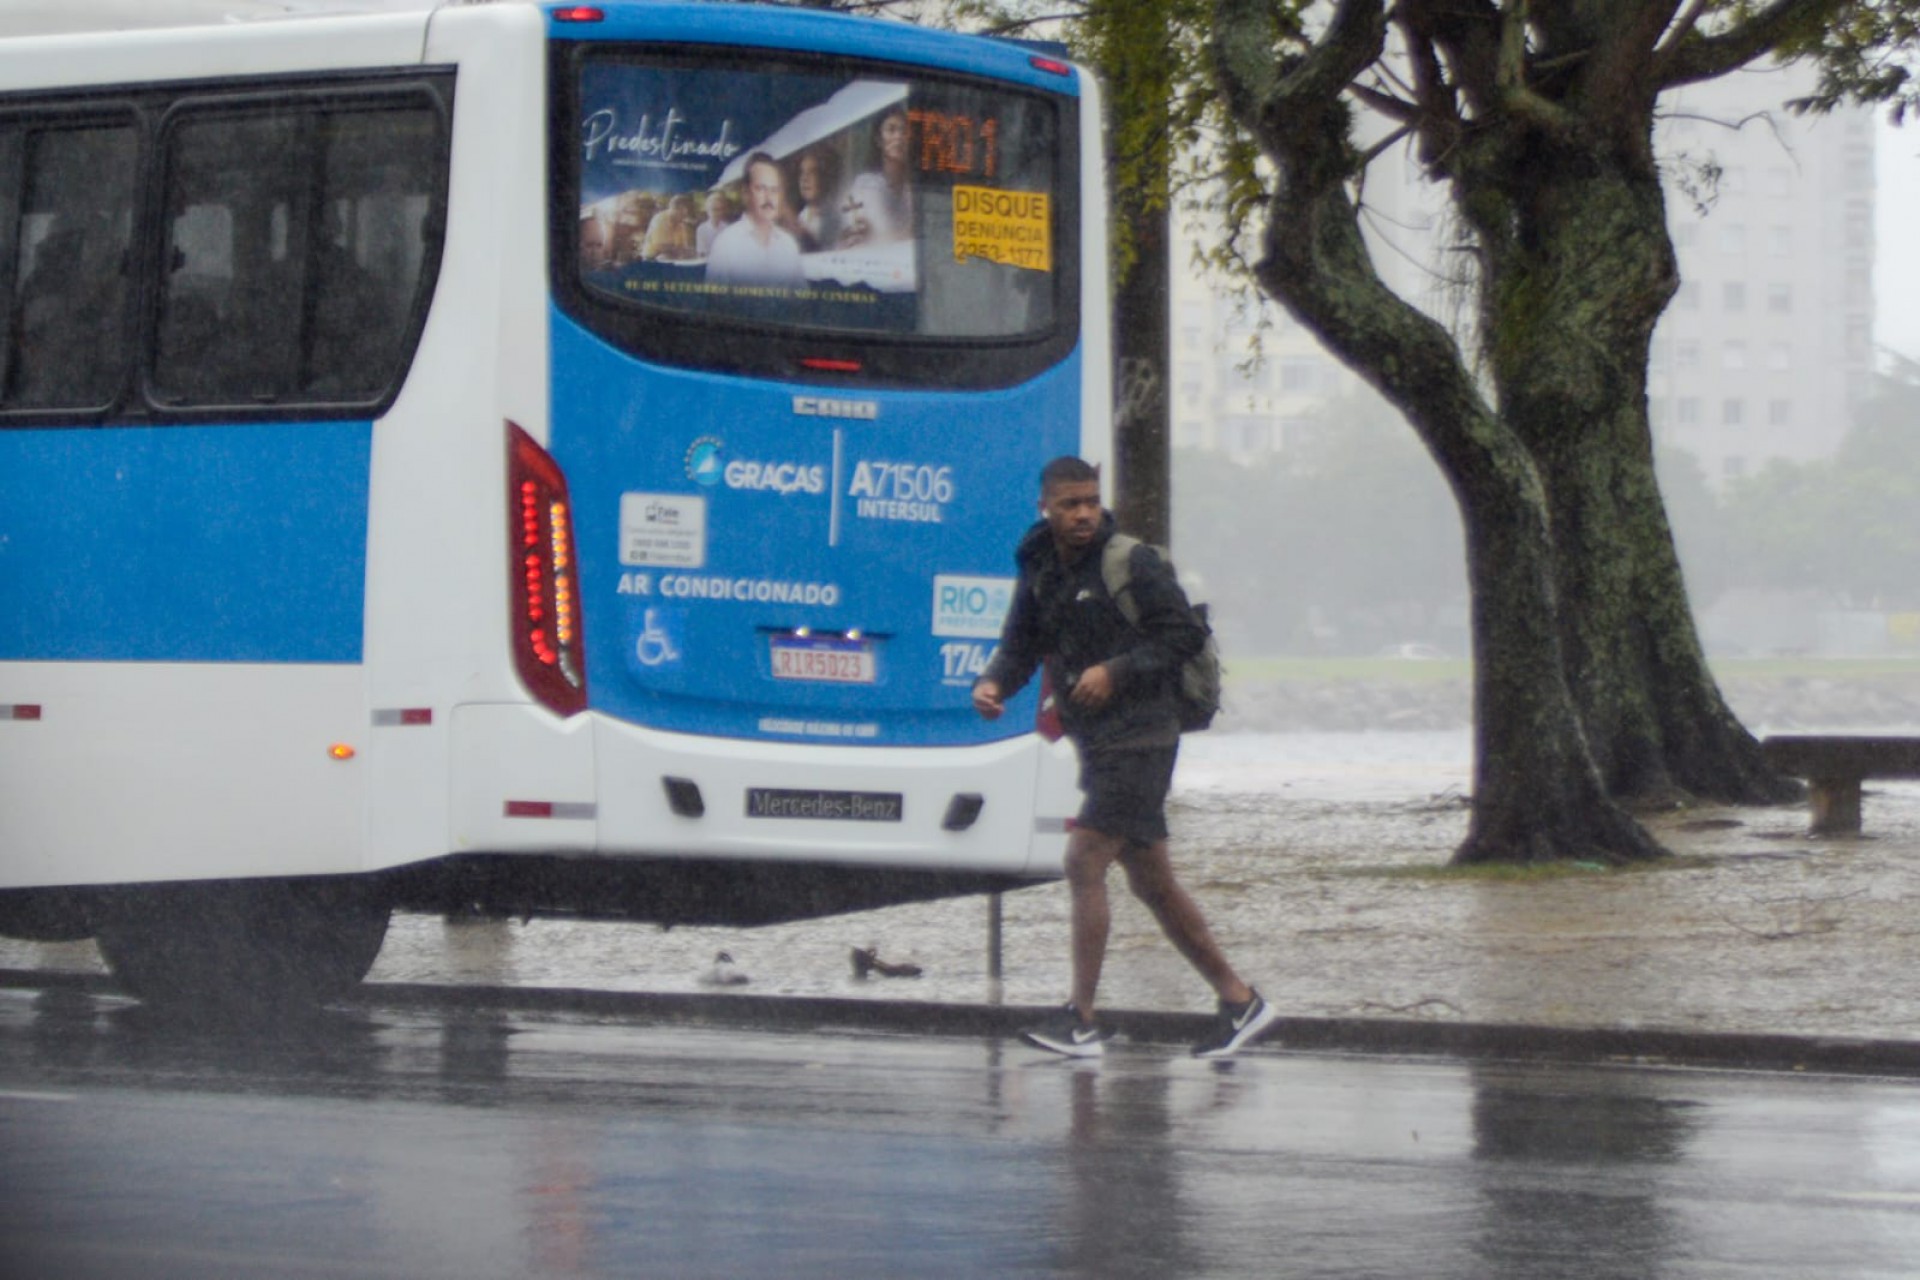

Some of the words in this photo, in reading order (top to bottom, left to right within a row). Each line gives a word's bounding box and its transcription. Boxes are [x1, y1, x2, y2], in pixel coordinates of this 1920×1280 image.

[582, 107, 739, 162] Predestinado
[956, 190, 1044, 220] DISQUE
[724, 460, 823, 495] GRAÇAS
[848, 460, 953, 503] A71506
[857, 499, 942, 522] INTERSUL
[616, 573, 650, 594] AR
[659, 575, 838, 606] CONDICIONADO
[941, 585, 988, 615] RIO
[753, 790, 898, 818] Mercedes-Benz
